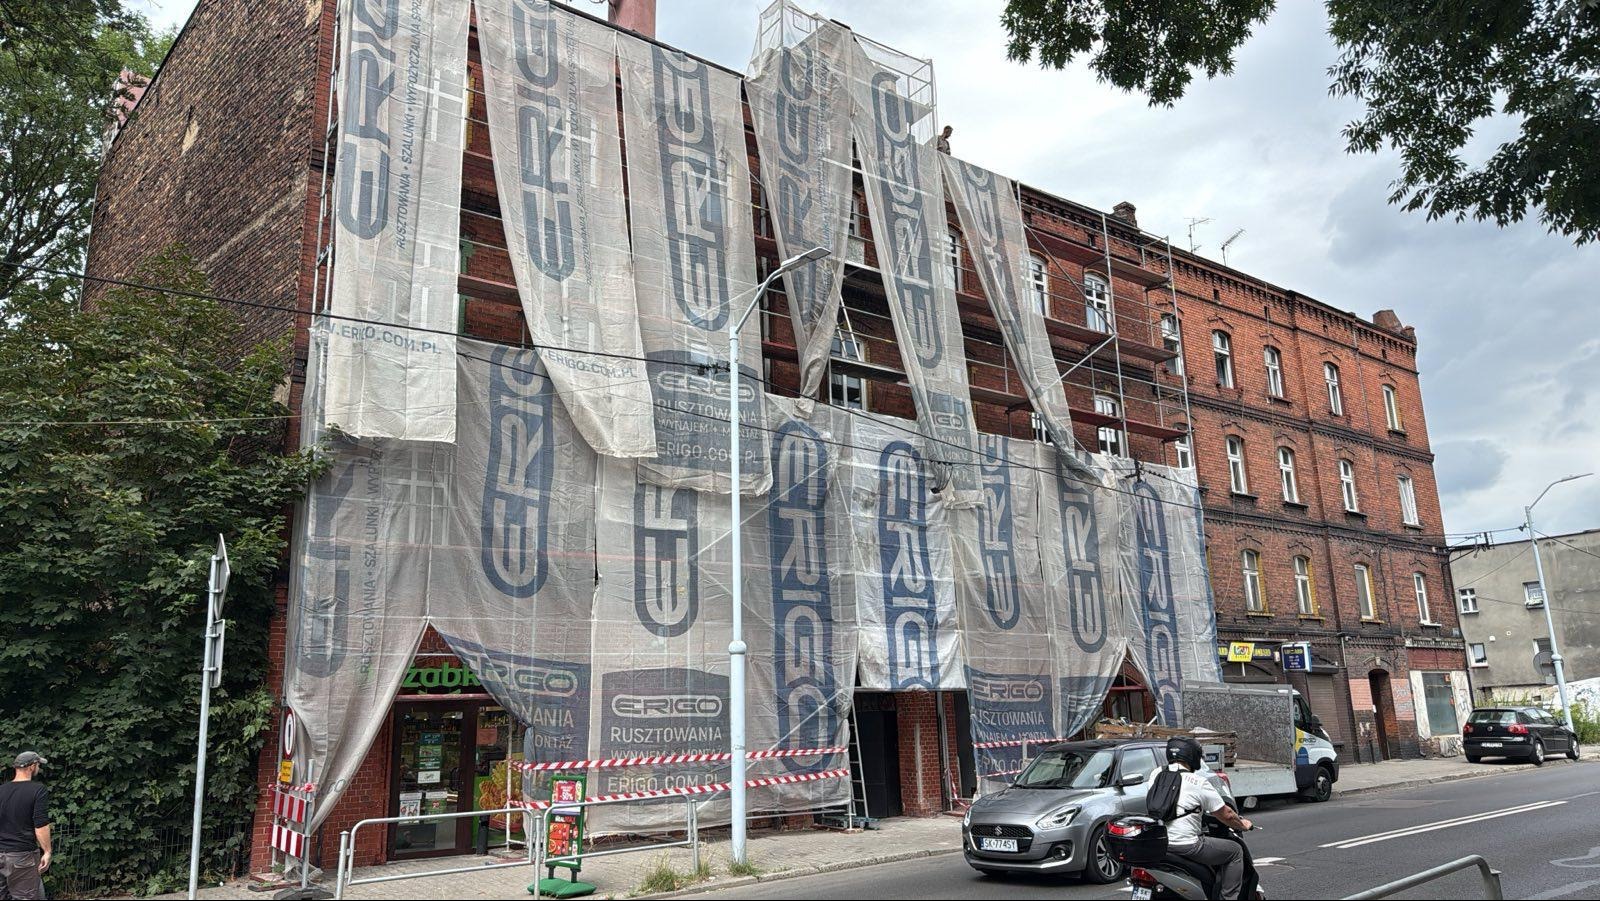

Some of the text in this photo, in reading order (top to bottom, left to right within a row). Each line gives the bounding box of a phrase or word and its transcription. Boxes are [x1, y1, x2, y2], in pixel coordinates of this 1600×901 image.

[400, 114, 416, 164] SZALUNKI
[395, 173, 412, 250] RUSZTOWANIA
[656, 399, 757, 422] RUSZTOWNIA
[657, 441, 758, 464] ERIGO.CO.PL
[363, 505, 380, 569] SZALUNKI
[612, 694, 722, 718] ERIGO
[611, 726, 722, 743] RUSZTOWANIA
